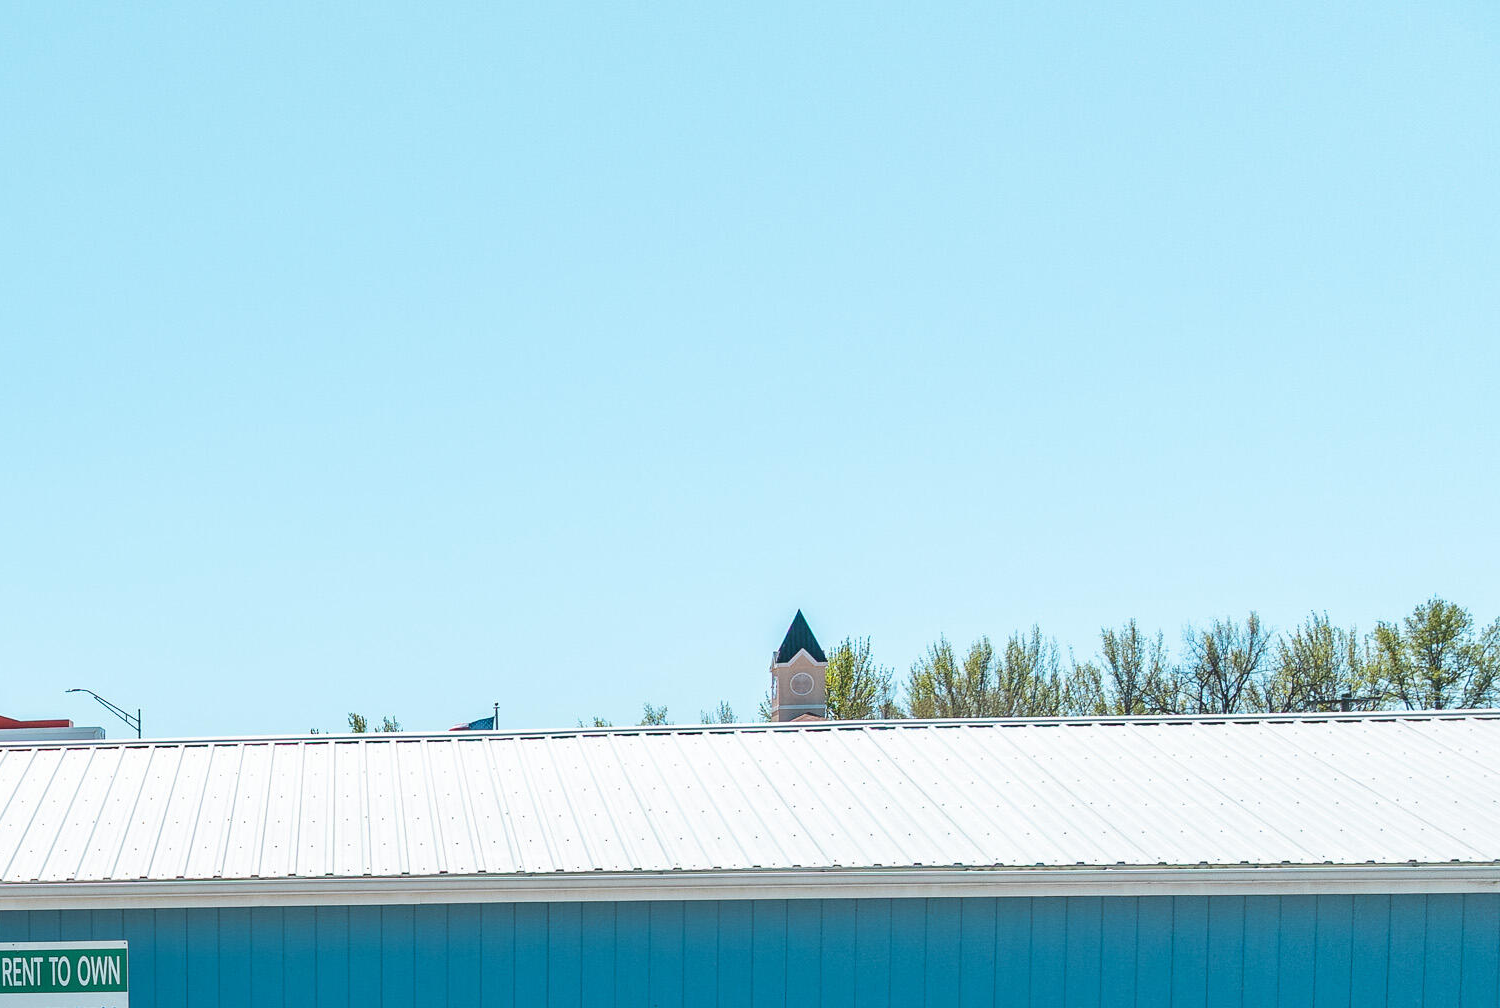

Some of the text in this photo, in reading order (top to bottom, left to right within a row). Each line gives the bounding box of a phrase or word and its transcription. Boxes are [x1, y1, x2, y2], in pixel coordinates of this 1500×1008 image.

[2, 956, 44, 987] RENT
[48, 955, 71, 986] TO
[77, 955, 121, 986] OWN
